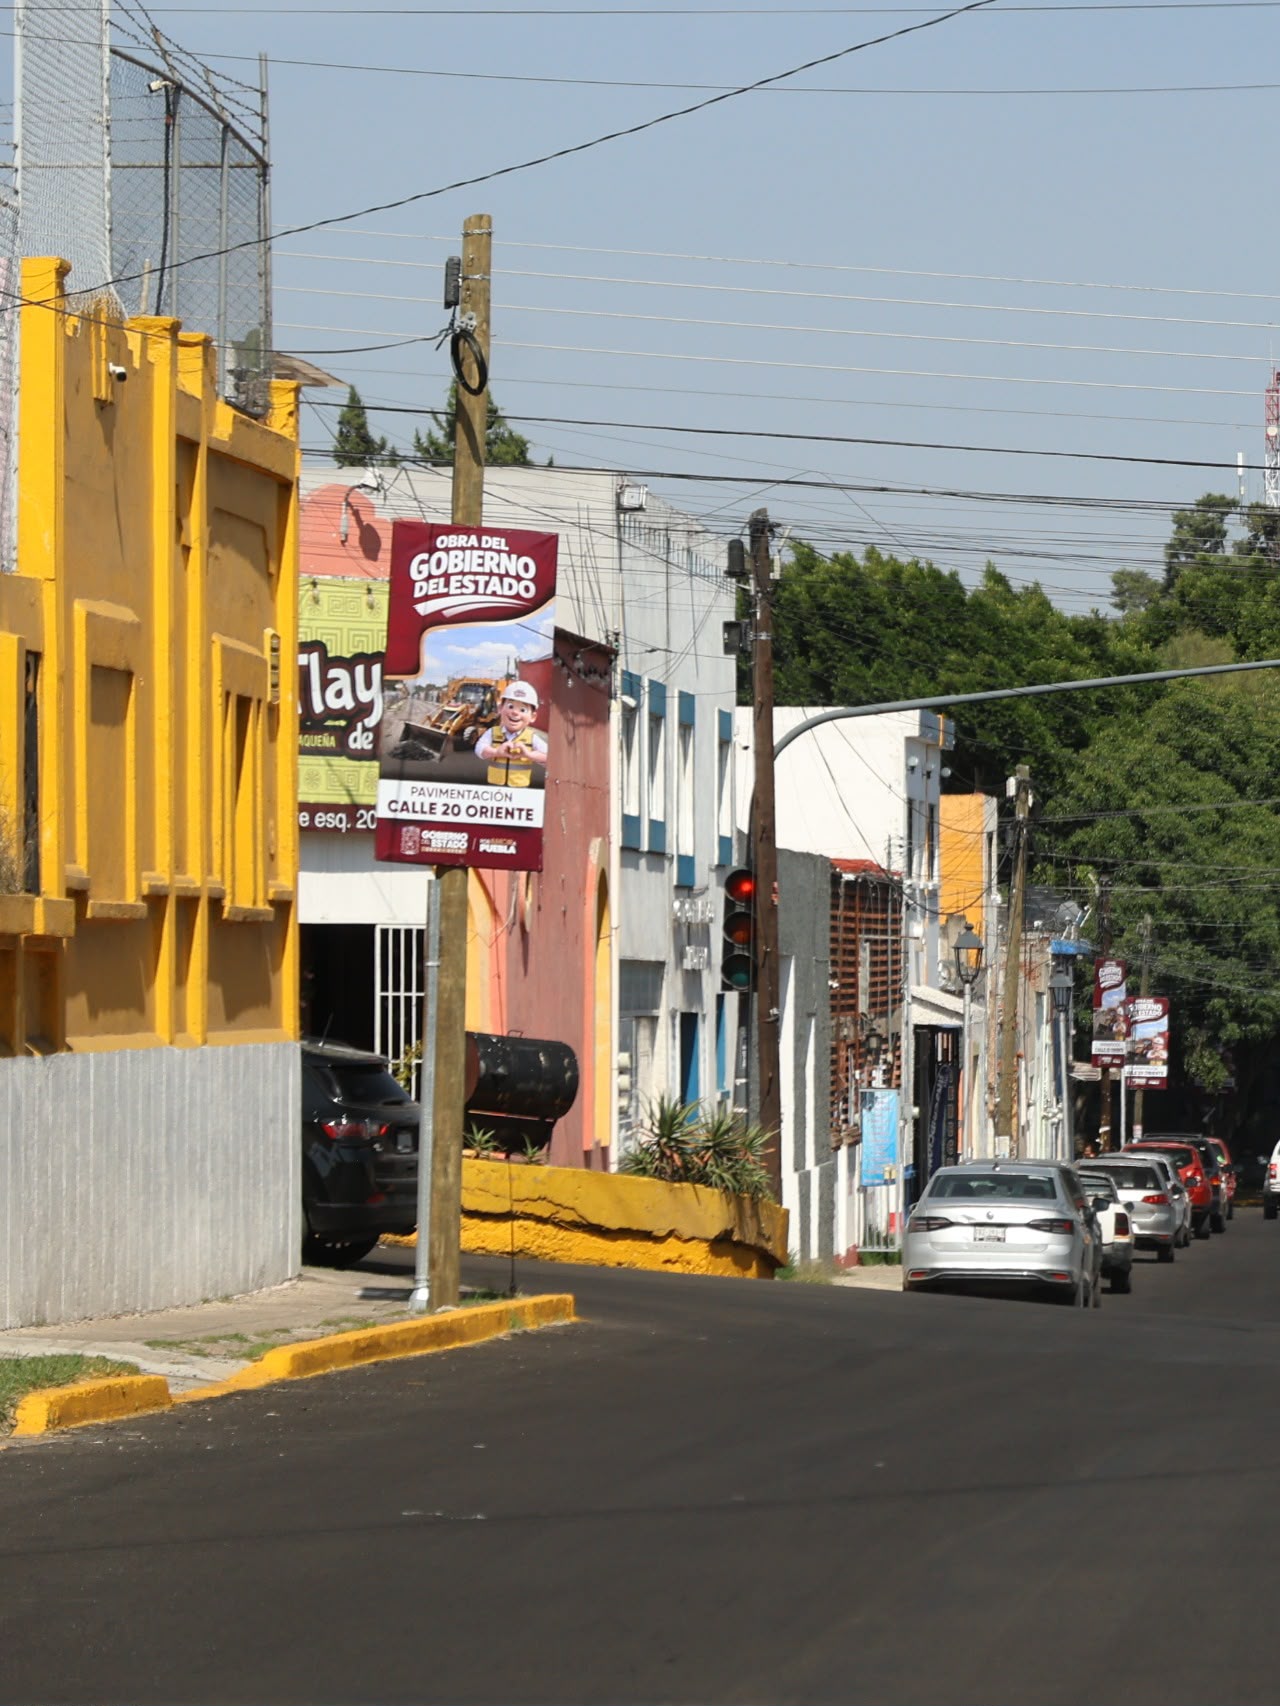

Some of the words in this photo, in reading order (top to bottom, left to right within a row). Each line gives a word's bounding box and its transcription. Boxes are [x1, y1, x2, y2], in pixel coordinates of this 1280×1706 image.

[436, 534, 478, 549] OBRA
[481, 536, 509, 551] DEL
[409, 550, 536, 581] GOBIERNO
[413, 577, 448, 598] DEL
[449, 574, 536, 599] ESTADO
[348, 721, 374, 750] de
[410, 786, 513, 803] PAVIMENTACIÓN
[387, 800, 437, 815] CALLE
[441, 803, 461, 817] 20
[465, 805, 534, 821] ORIENTE
[314, 811, 351, 833] esq.
[356, 809, 377, 829] 20
[421, 830, 468, 841] GOBIERNO
[431, 840, 468, 849] ESTADO
[479, 843, 517, 854] PUEBLA
